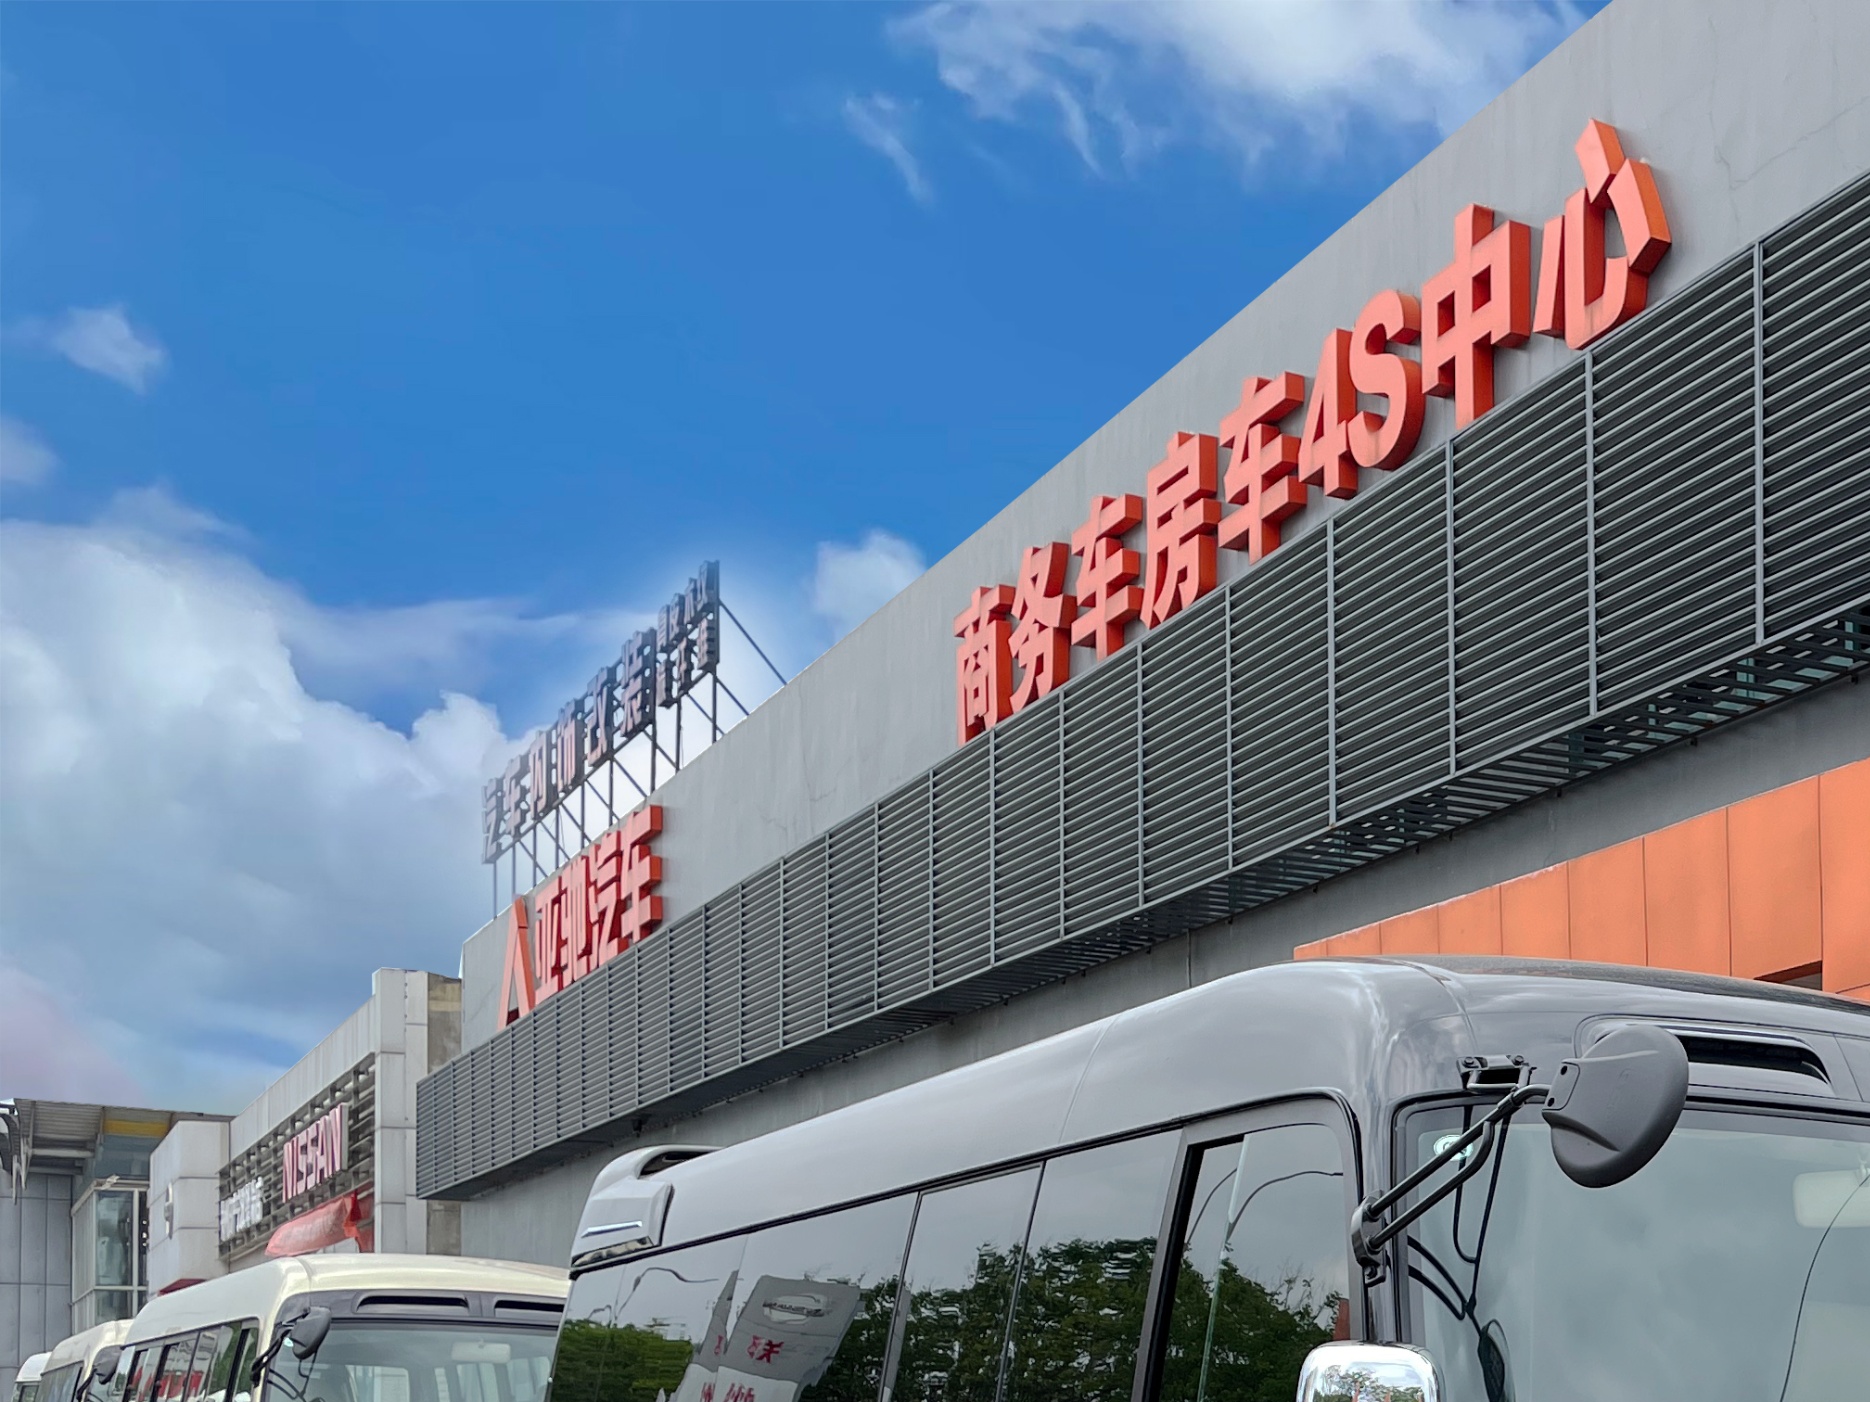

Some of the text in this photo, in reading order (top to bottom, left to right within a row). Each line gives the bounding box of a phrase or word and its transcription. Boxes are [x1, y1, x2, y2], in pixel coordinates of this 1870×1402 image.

[953, 117, 1672, 746] 商务车房车4S中心
[282, 1102, 349, 1203] NISSAN
